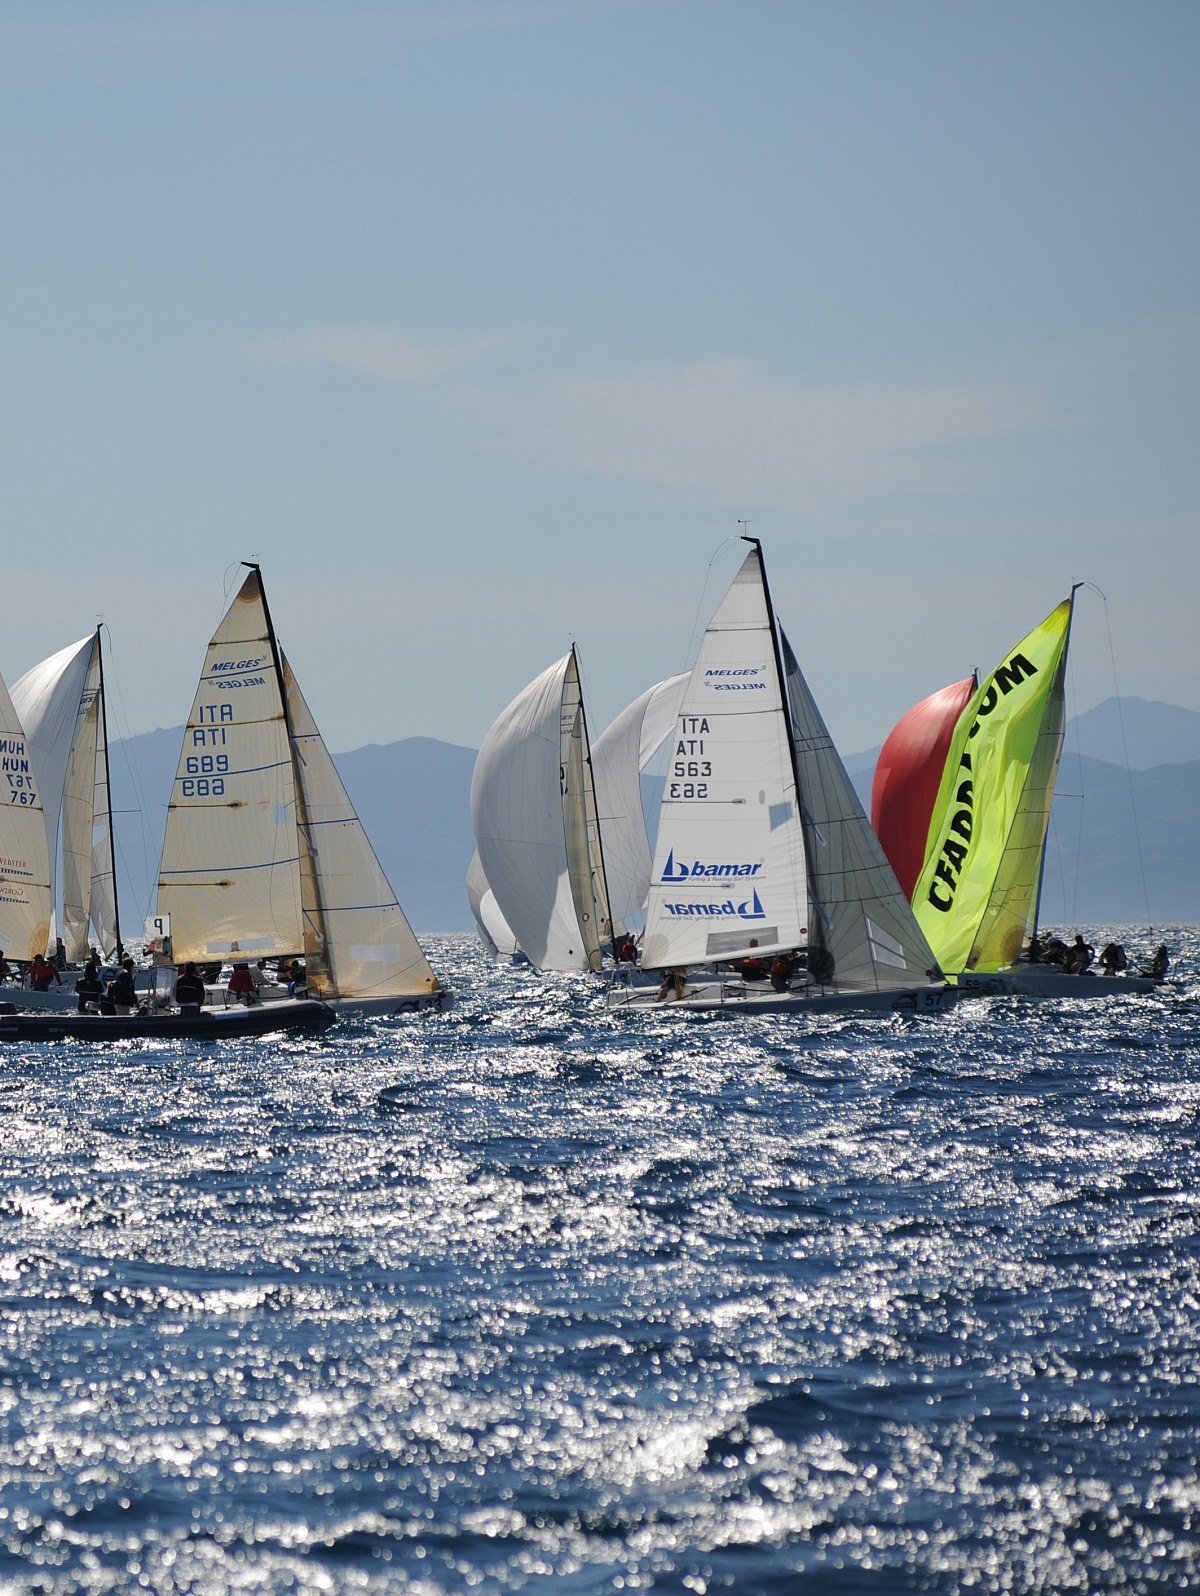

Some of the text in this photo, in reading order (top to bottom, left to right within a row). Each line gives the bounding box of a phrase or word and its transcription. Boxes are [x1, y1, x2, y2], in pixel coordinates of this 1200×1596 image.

[211, 658, 260, 671] MELGES
[200, 704, 233, 723] ITA
[682, 718, 710, 734] ITA
[2, 757, 29, 773] HUN
[186, 755, 228, 773] 689
[674, 762, 711, 777] 563
[11, 791, 36, 806] 767
[691, 861, 762, 877] bamar
[924, 993, 944, 1006] 57
